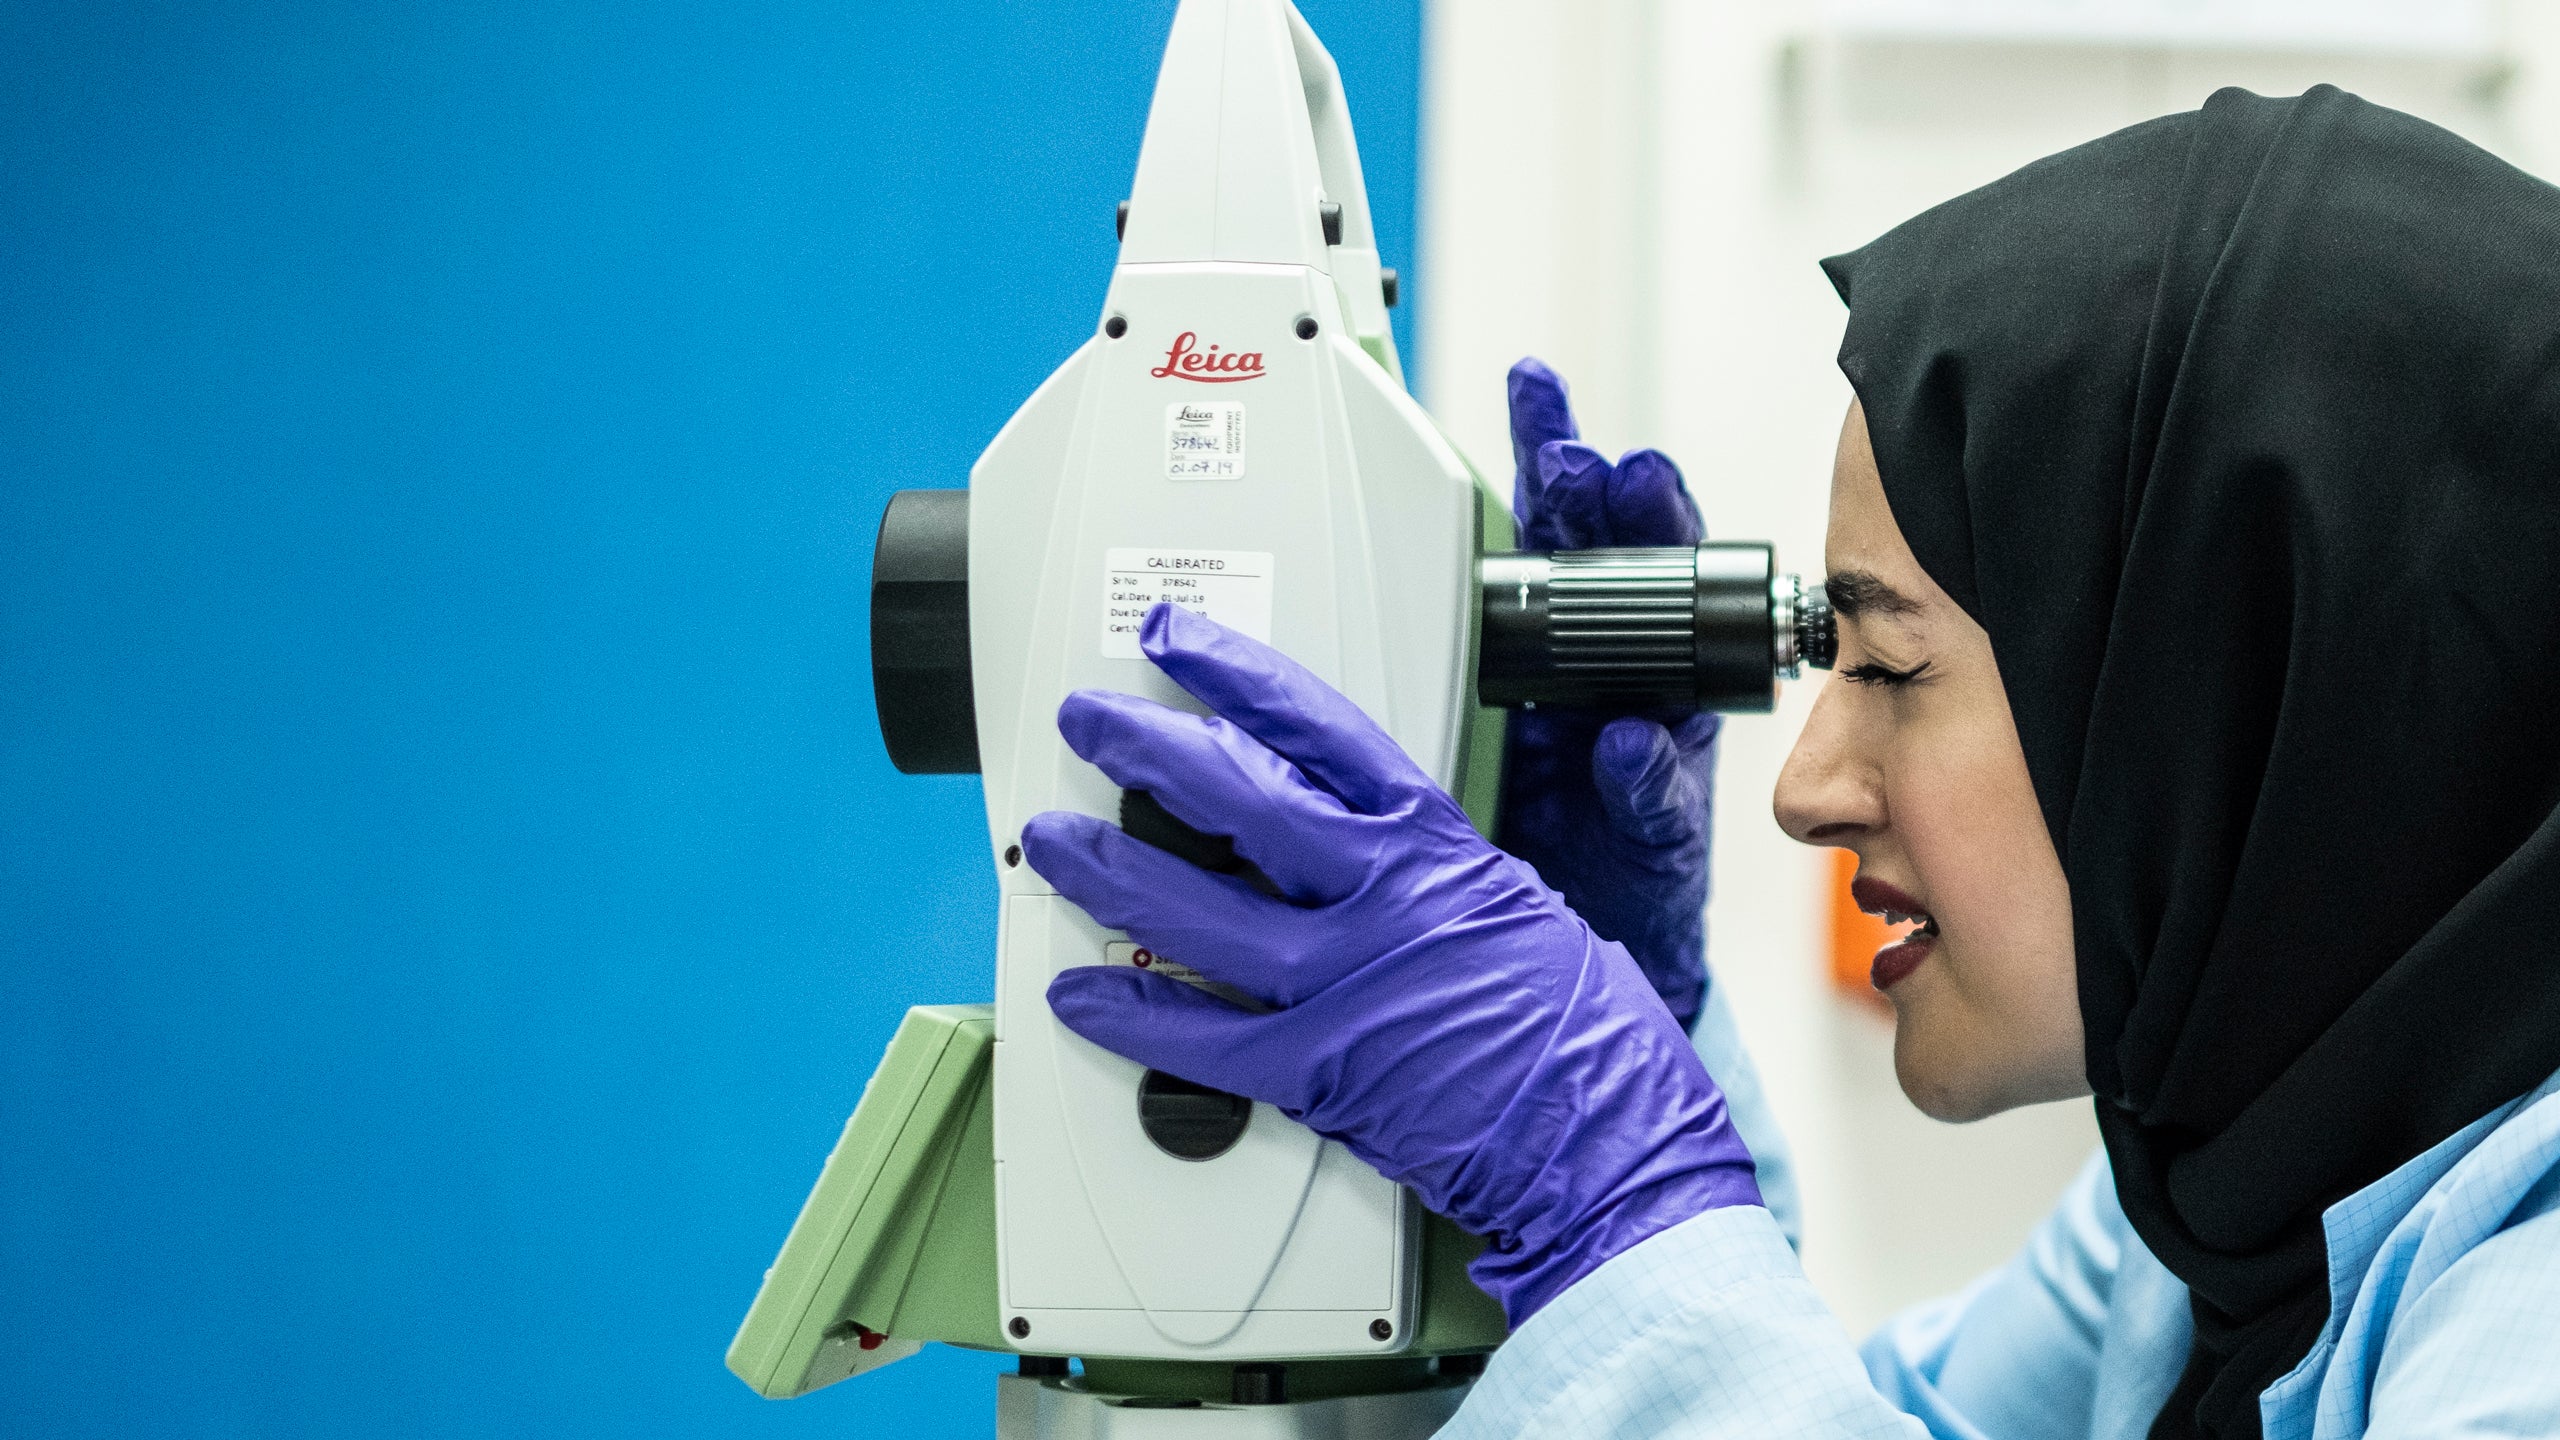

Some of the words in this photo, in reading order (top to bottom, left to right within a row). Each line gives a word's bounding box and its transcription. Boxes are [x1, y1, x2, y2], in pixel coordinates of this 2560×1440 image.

[1150, 331, 1267, 383] Leica
[1175, 405, 1214, 422] Leica
[1147, 557, 1225, 570] CALIBRATED
[1124, 577, 1138, 586] No
[1162, 578, 1198, 588] 378542
[1111, 592, 1152, 602] Cal.Date
[1110, 608, 1129, 617] Due
[1131, 609, 1147, 618] Da
[1109, 624, 1140, 633] Cert.N
